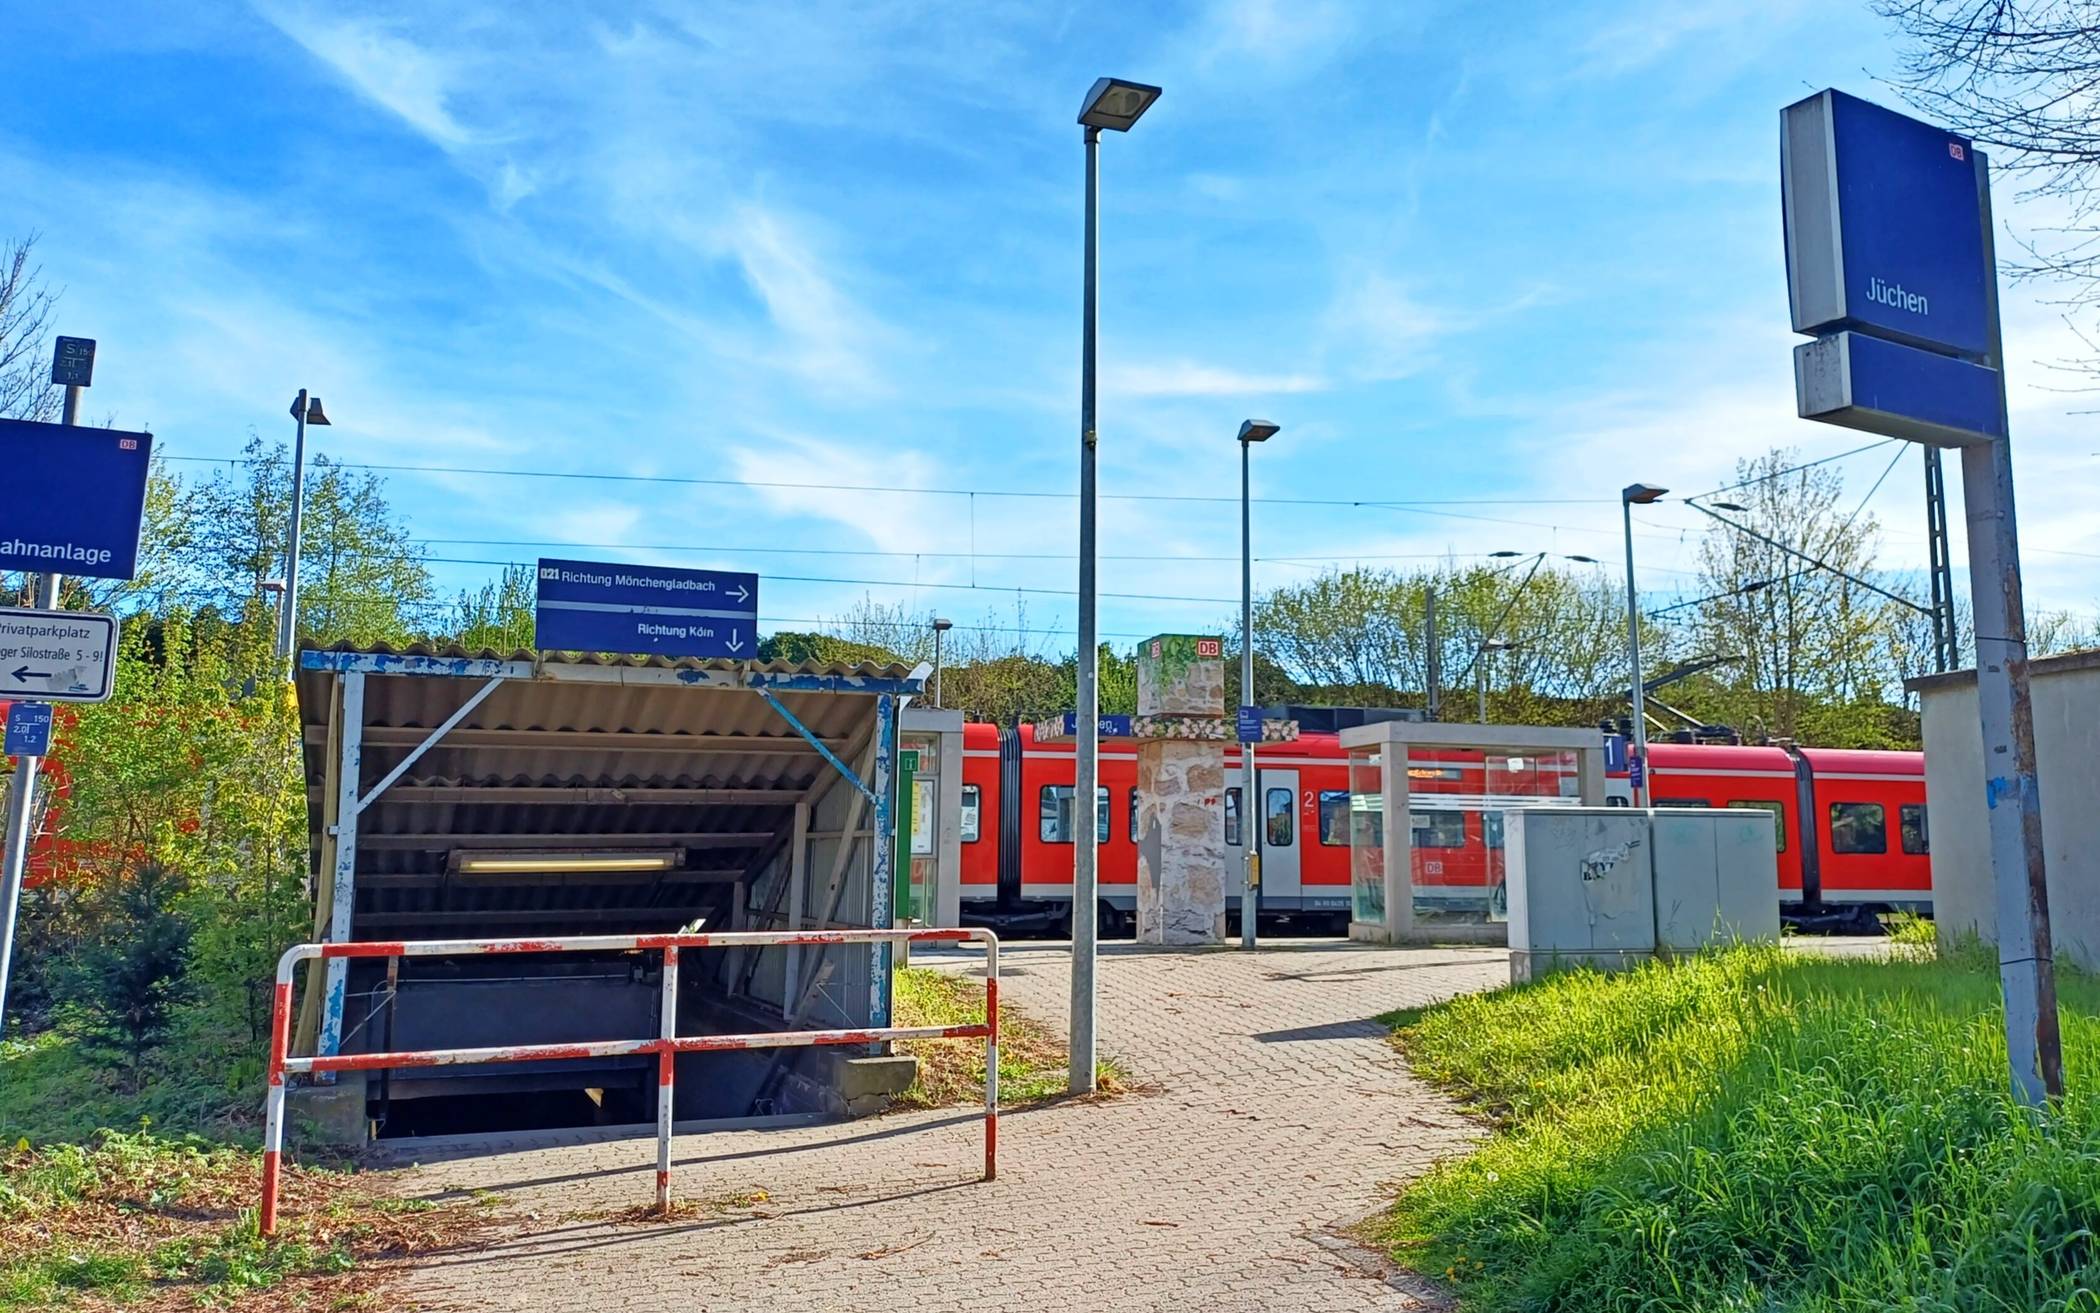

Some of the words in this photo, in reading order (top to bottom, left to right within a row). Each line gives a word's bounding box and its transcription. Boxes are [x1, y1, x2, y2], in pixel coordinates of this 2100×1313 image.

[1949, 144, 1963, 160] DB
[1866, 276, 1929, 316] Jüchen
[121, 440, 136, 449] DB
[0, 539, 112, 566] ahnanlage
[561, 571, 612, 588] Richtung
[615, 574, 716, 592] Mönchengladbach
[0, 623, 91, 640] rivatparkplatz
[638, 623, 687, 638] Richtung
[20, 646, 70, 661] Silostraße
[76, 649, 83, 661] 5
[92, 650, 104, 662] 9!
[1198, 642, 1218, 655] DB
[15, 714, 21, 723] S
[34, 715, 49, 723] 150
[24, 735, 37, 743] 1.2
[1605, 738, 1614, 765] 1
[1304, 791, 1314, 808] 2
[1426, 862, 1441, 873] DB
